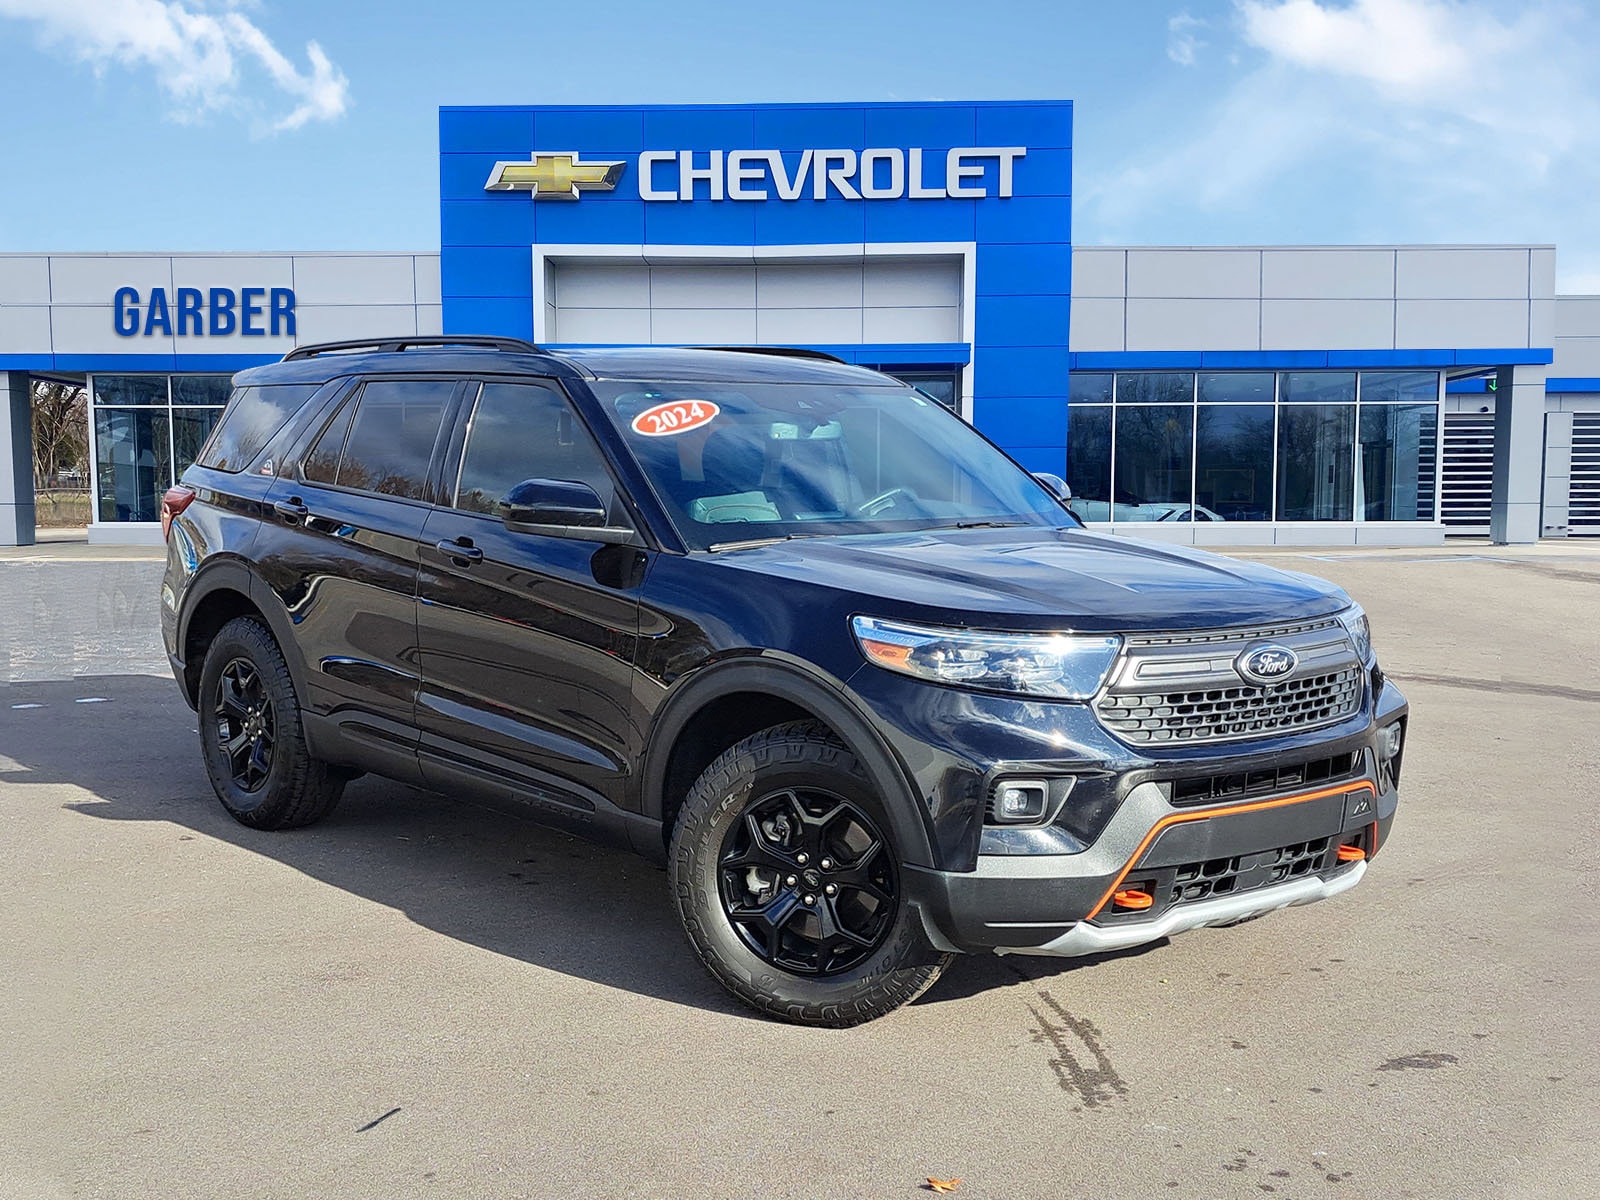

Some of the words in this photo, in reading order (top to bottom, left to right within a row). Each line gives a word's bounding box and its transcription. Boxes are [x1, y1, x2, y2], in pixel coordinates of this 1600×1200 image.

[638, 146, 1027, 201] CHEVROLET
[114, 286, 297, 337] GARBER
[647, 402, 705, 433] 2024
[1258, 653, 1289, 674] Ford
